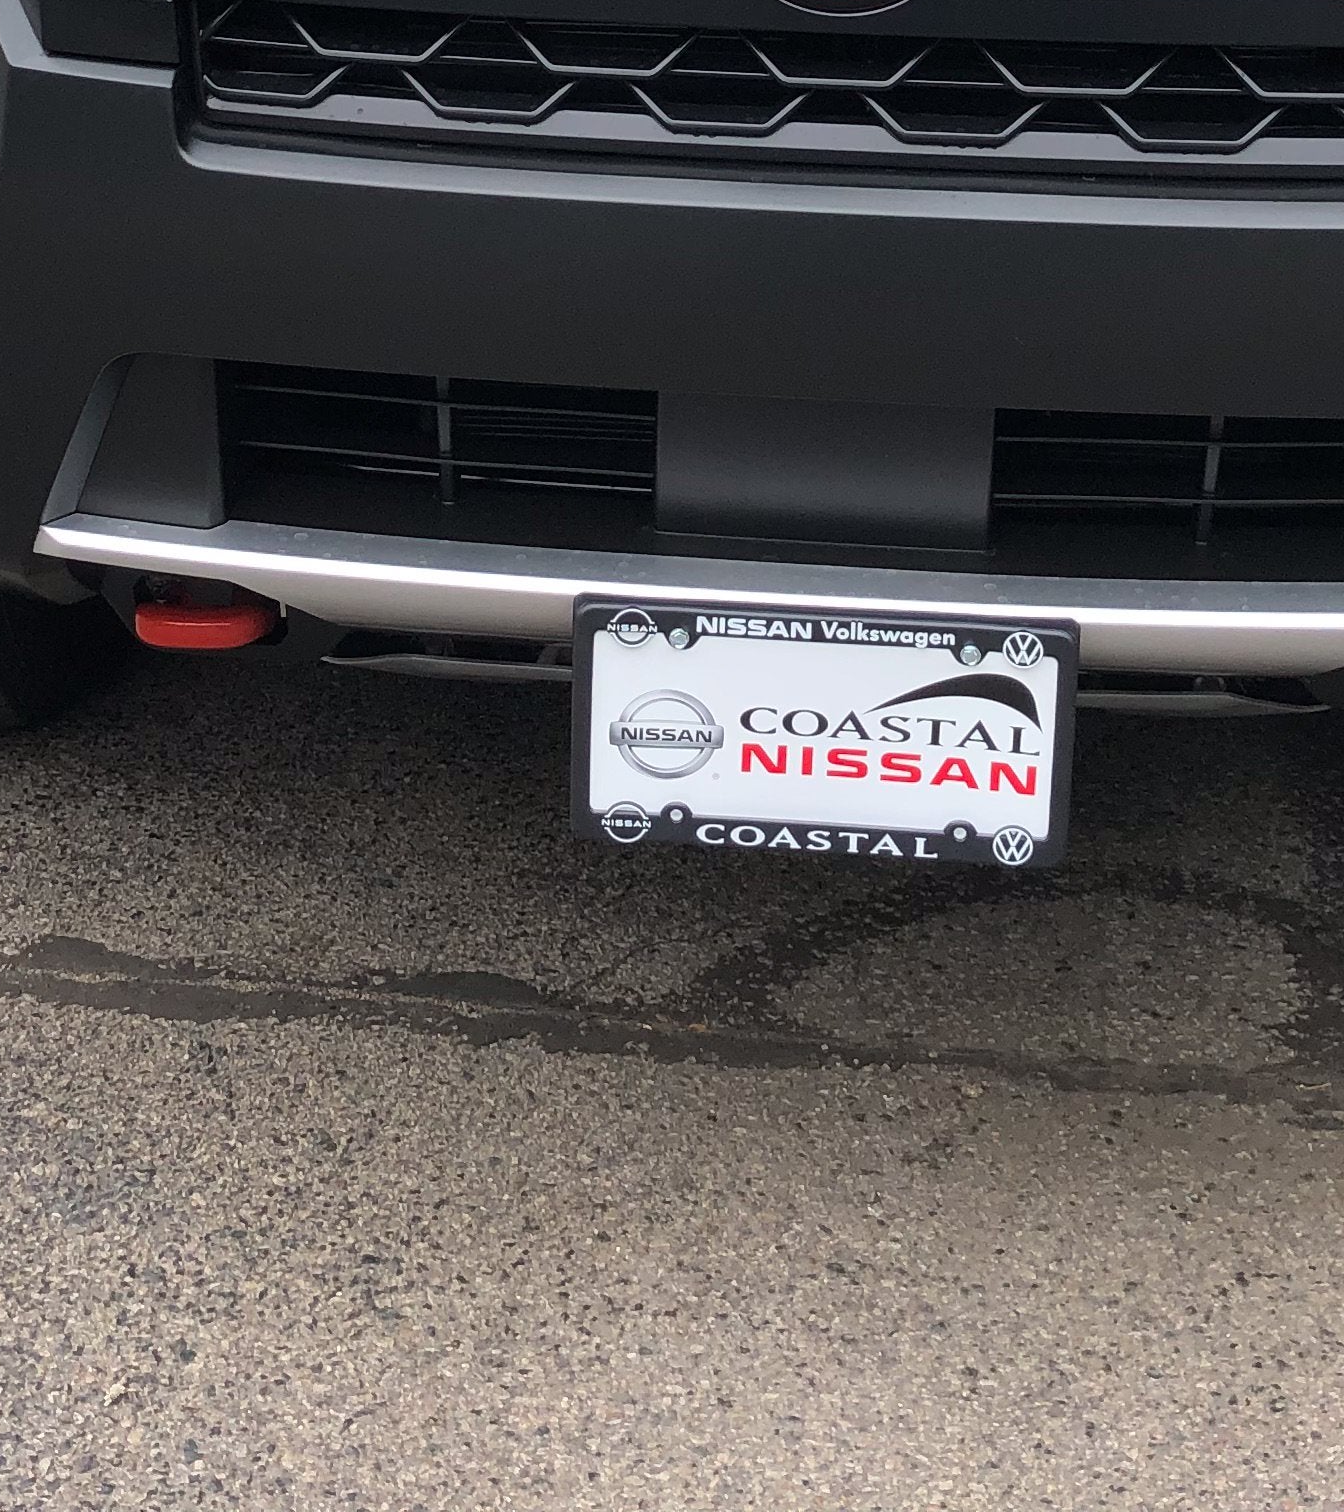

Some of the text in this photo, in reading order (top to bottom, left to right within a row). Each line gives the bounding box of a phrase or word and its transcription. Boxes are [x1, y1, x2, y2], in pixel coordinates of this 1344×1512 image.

[607, 623, 657, 633] NISSAN
[696, 615, 956, 648] NISSAN Volkswagen
[621, 726, 712, 743] NISSAN
[740, 707, 1041, 757] COASTAL
[741, 743, 1037, 796] NISSAN
[601, 818, 652, 830] NISSAN
[696, 823, 938, 859] COASTAL
